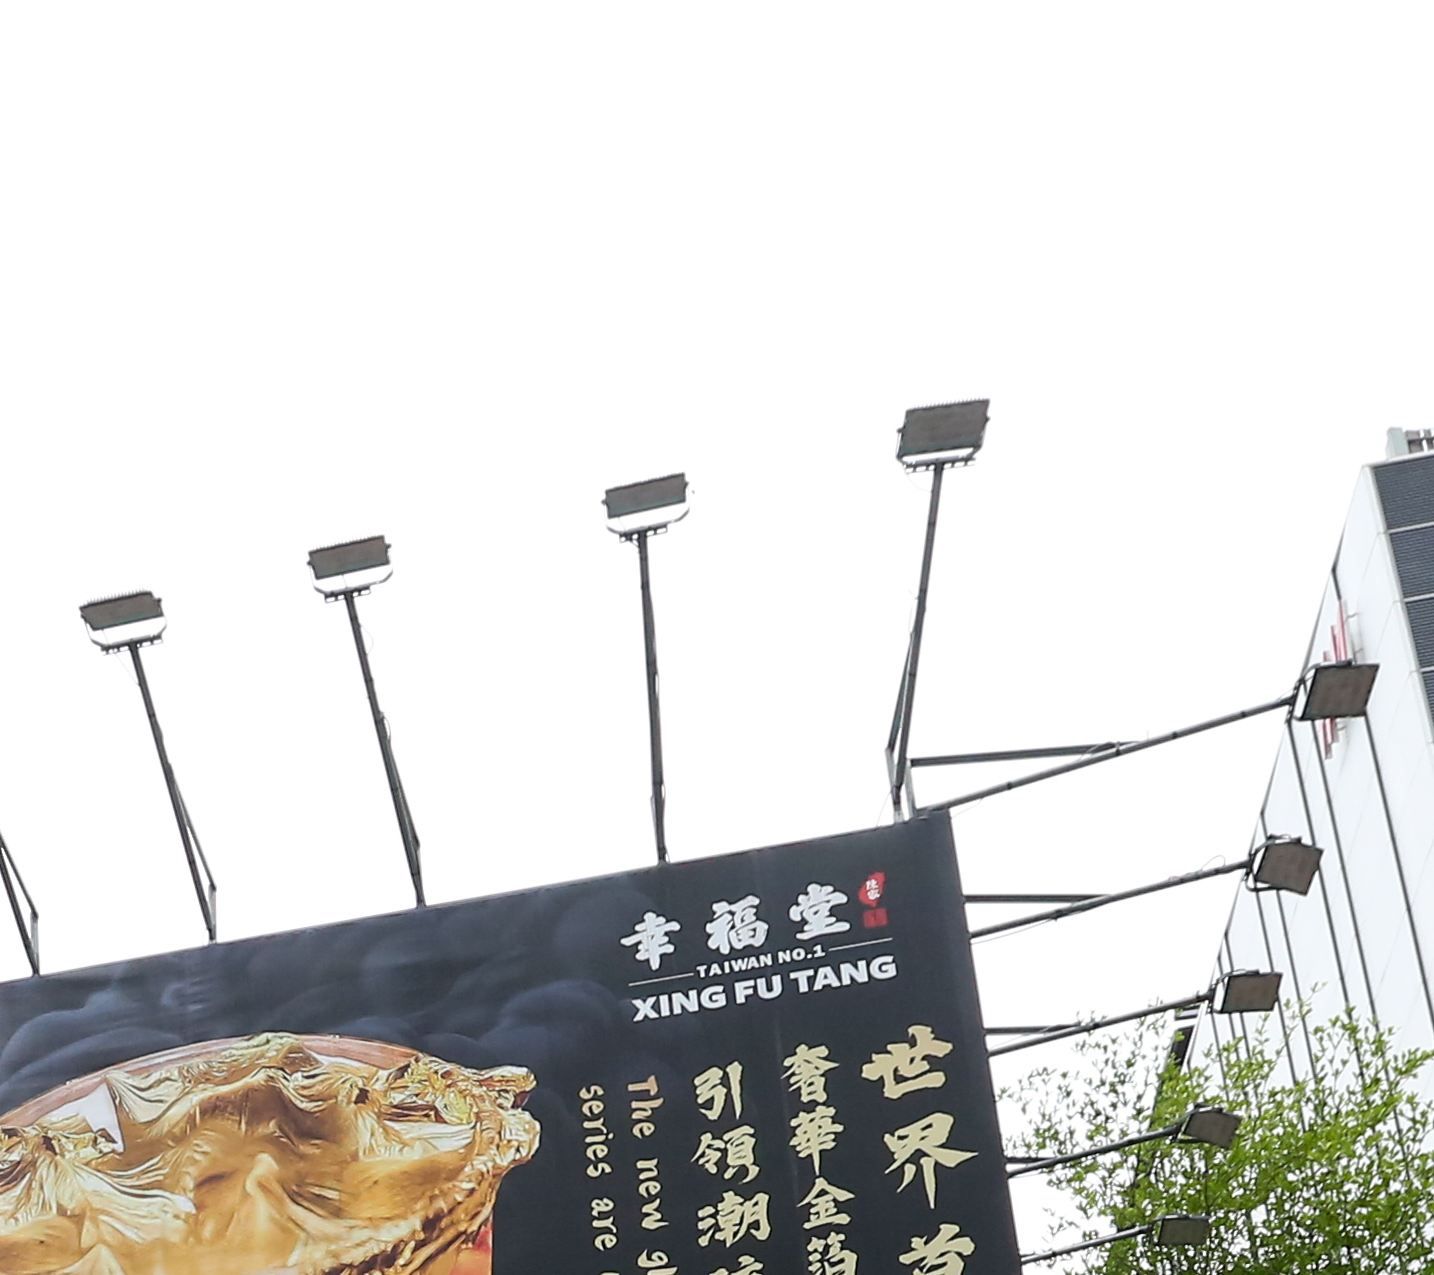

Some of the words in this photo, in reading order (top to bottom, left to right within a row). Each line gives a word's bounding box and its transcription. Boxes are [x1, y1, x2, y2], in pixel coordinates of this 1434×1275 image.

[620, 883, 851, 971] 幸福堂
[632, 984, 727, 1022] XING
[733, 973, 783, 1004] FU
[790, 954, 897, 992] TANG
[696, 954, 771, 978] TAIWAN
[777, 945, 826, 966] NO.1
[579, 1084, 613, 1179] series
[627, 1075, 664, 1138] The
[591, 1198, 619, 1252] are
[637, 1157, 669, 1230] new
